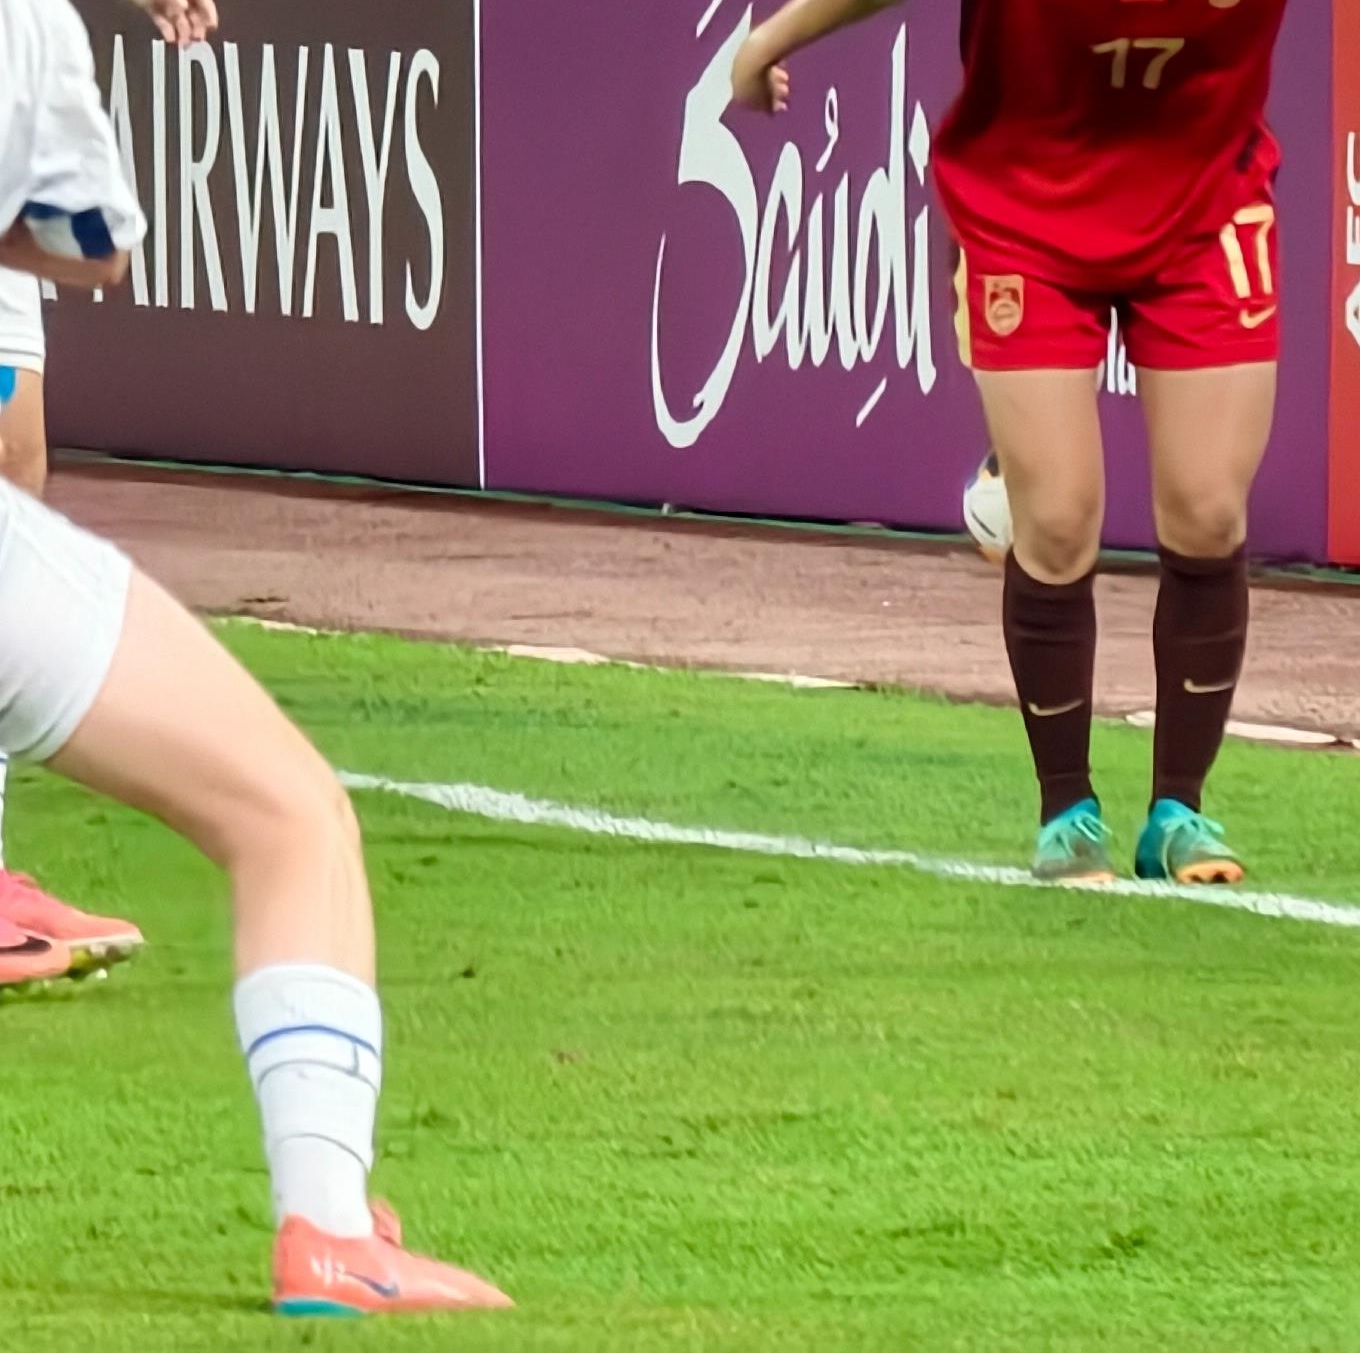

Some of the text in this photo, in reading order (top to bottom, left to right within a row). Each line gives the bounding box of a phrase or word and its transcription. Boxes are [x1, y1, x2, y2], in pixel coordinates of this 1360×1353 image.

[1092, 37, 1186, 90] 17
[94, 34, 444, 331] AIRWAYS
[1219, 203, 1275, 299] 17
